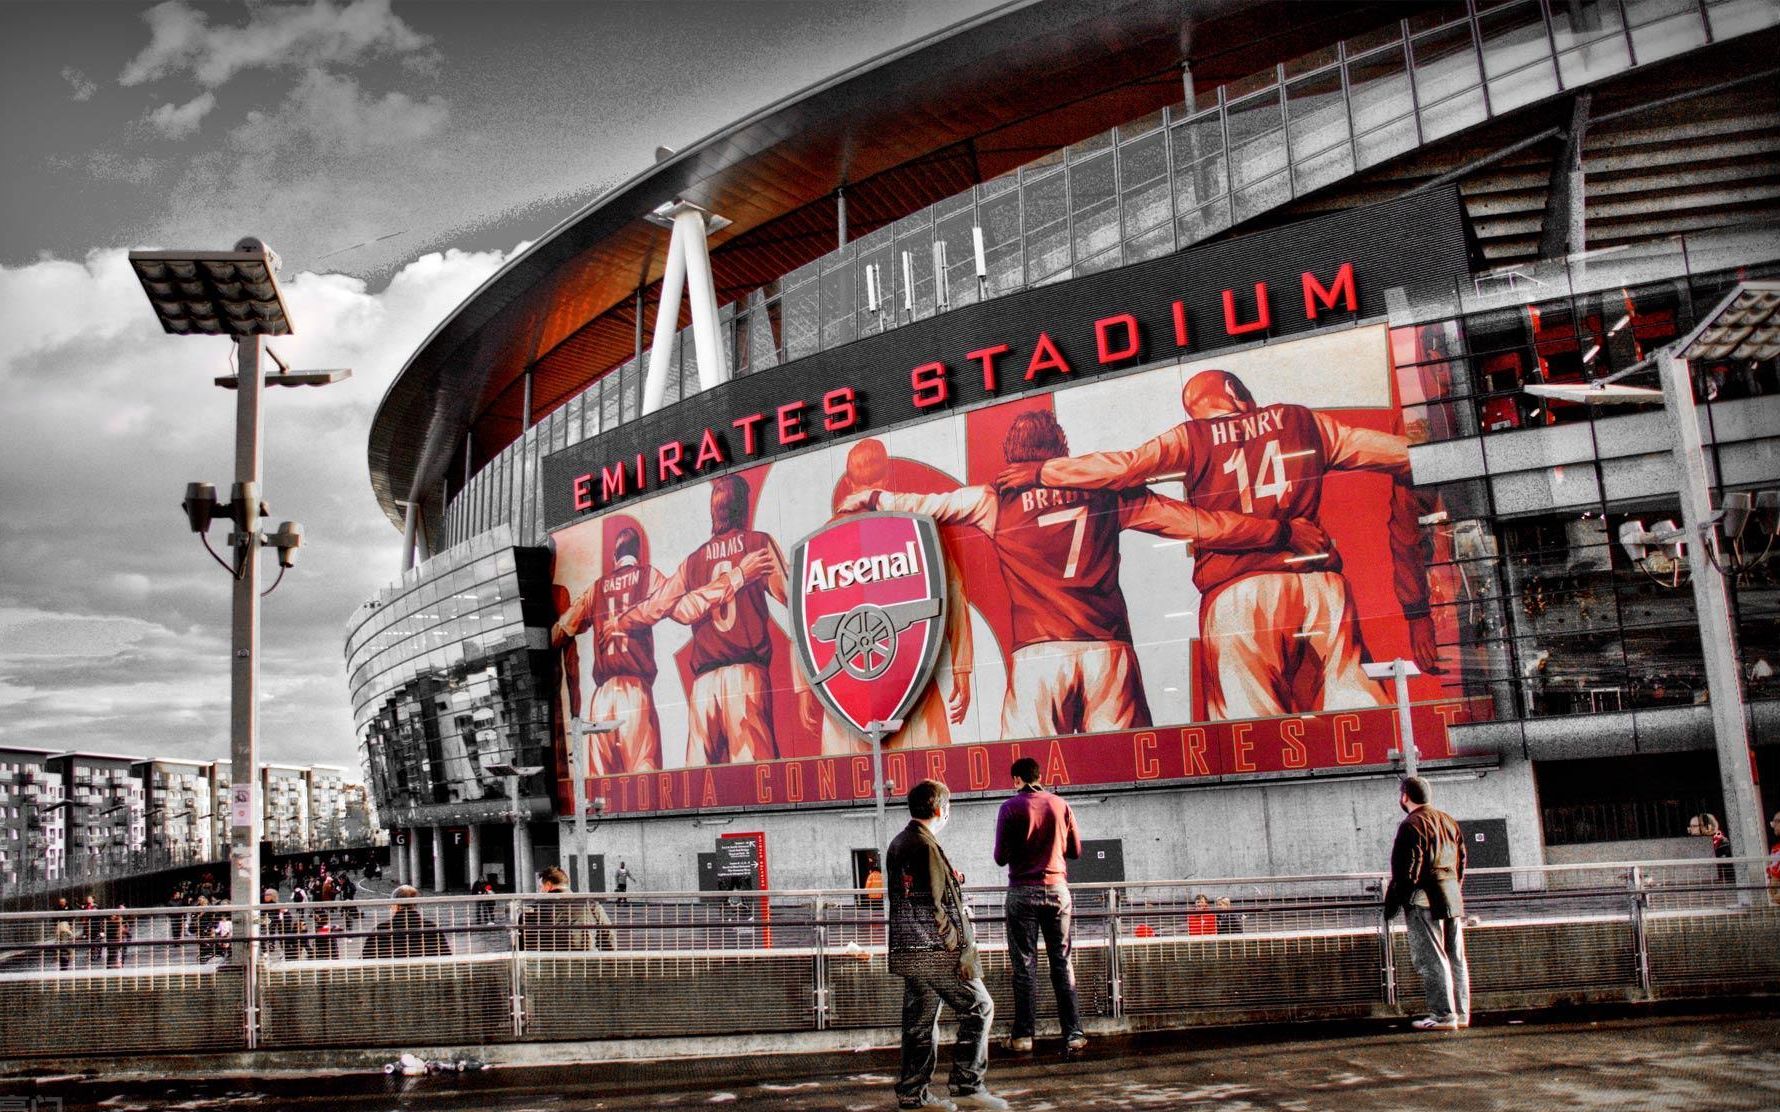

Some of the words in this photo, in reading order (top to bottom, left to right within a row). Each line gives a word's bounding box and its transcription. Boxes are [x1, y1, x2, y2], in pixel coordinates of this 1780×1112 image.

[573, 385, 859, 512] EMIRATES
[911, 262, 1358, 408] STADIUM
[1210, 407, 1285, 446] HENRY
[1222, 439, 1293, 514] 14
[706, 534, 745, 561] ADAMS
[1037, 504, 1089, 579] 7
[603, 570, 641, 594] BASTIN
[806, 541, 921, 595] Arsenal
[396, 834, 405, 845] G
[454, 833, 462, 845] F
